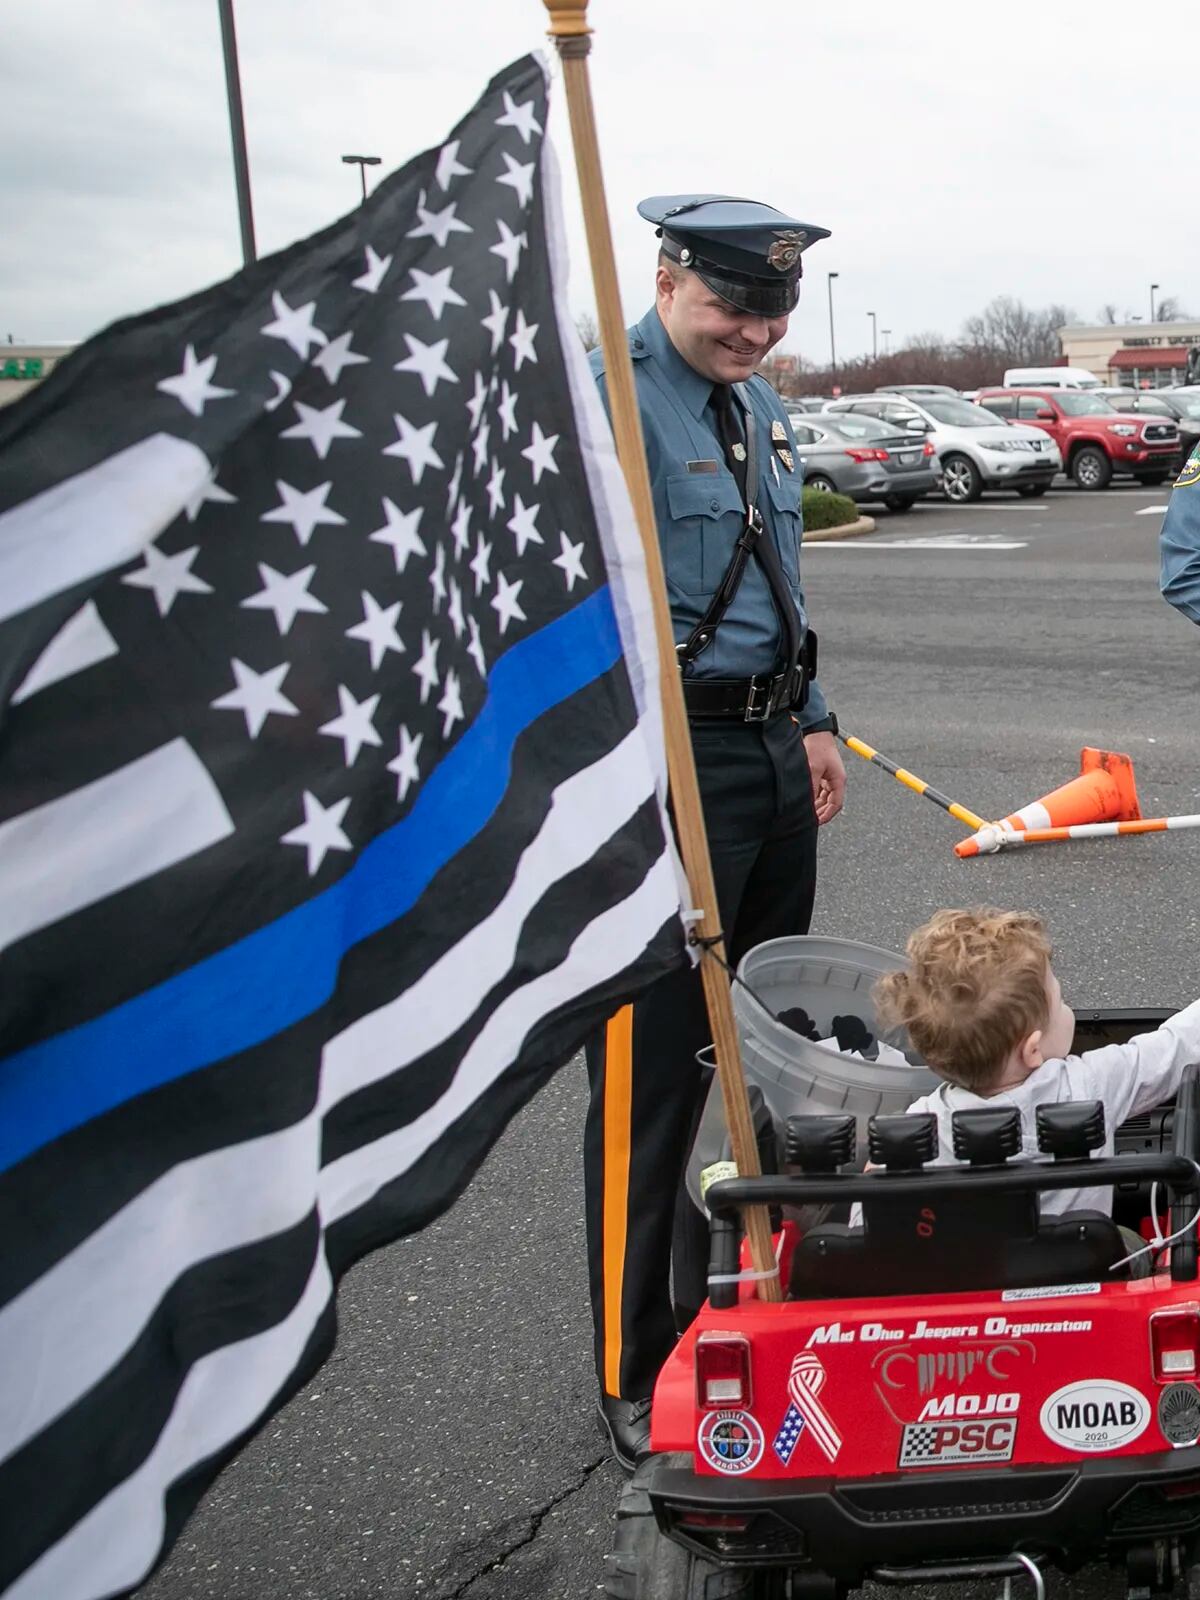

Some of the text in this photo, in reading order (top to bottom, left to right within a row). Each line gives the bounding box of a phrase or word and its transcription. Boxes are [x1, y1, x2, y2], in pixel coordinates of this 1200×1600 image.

[805, 1317, 1092, 1349] Mid Ohio Jeepers Organization
[917, 1392, 1021, 1422] MOJO
[1057, 1401, 1137, 1430] MOAB
[932, 1422, 1012, 1455] PSC
[1085, 1432, 1109, 1442] 2020
